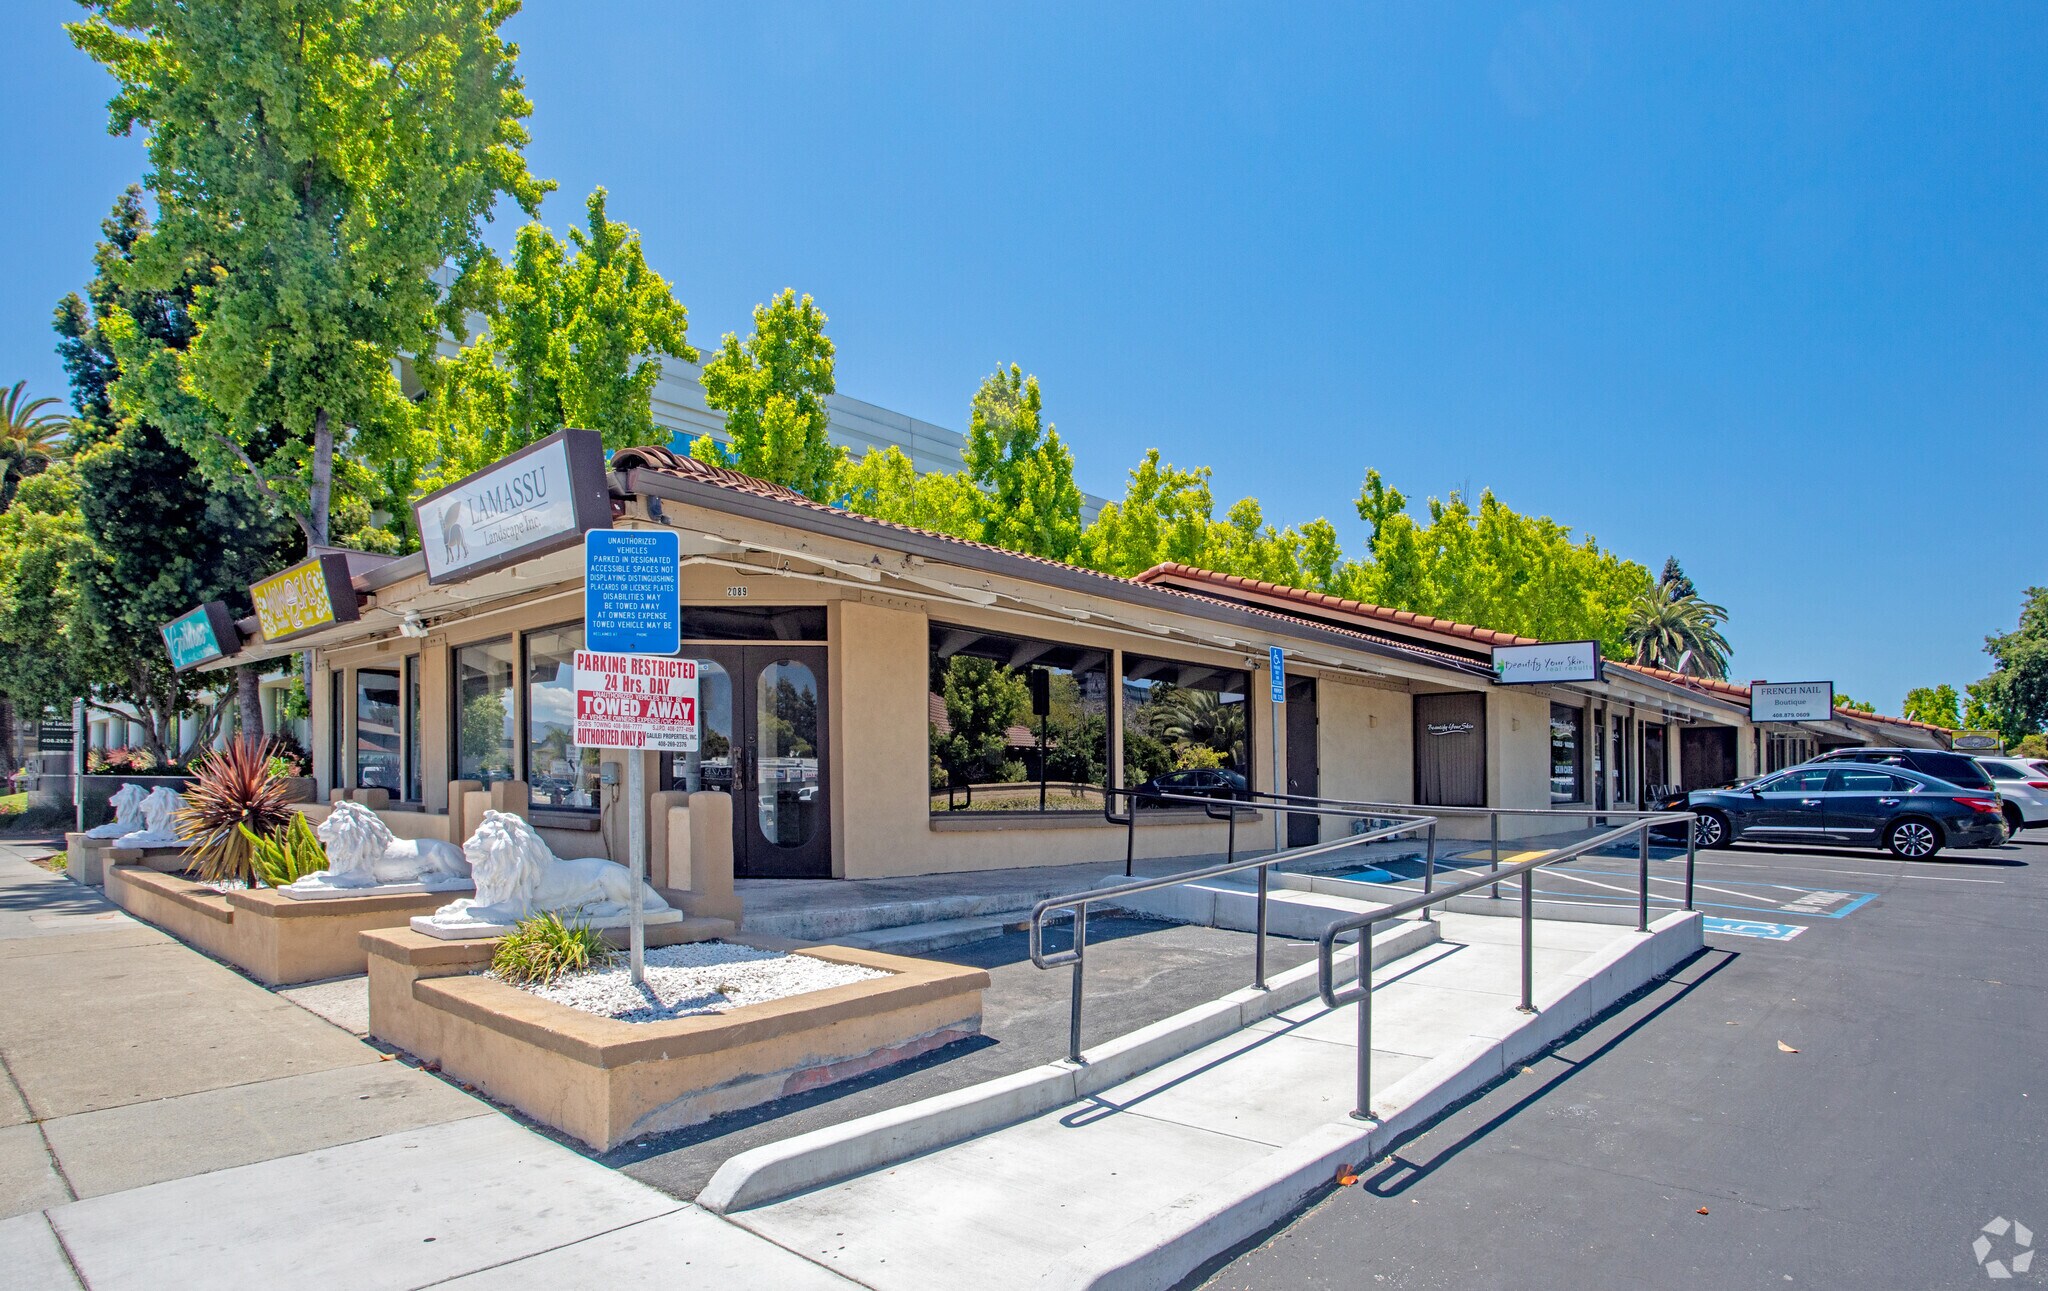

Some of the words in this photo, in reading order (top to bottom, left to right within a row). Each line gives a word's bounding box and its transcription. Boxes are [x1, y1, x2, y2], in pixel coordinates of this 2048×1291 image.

[468, 466, 548, 525] LAMASSU
[484, 522, 524, 546] Landscape
[525, 516, 541, 535] Inc.
[628, 574, 674, 583] DISTINGUISHING
[728, 587, 746, 596] 2089
[578, 653, 626, 674] PARKING
[631, 658, 695, 679] RESTRICTED
[1505, 657, 1542, 671] Beautify
[1544, 658, 1564, 668] Your
[1567, 656, 1584, 666] Skin
[605, 674, 618, 691] 24
[622, 676, 645, 693] Hrs.
[650, 678, 670, 695] DAY
[593, 691, 633, 699] UNAUTHORIZED
[582, 696, 640, 716] TOWED
[646, 700, 691, 719] AWAY
[578, 728, 618, 745] AUTHORIZED
[621, 730, 636, 746] ONLY
[637, 731, 646, 747] BY
